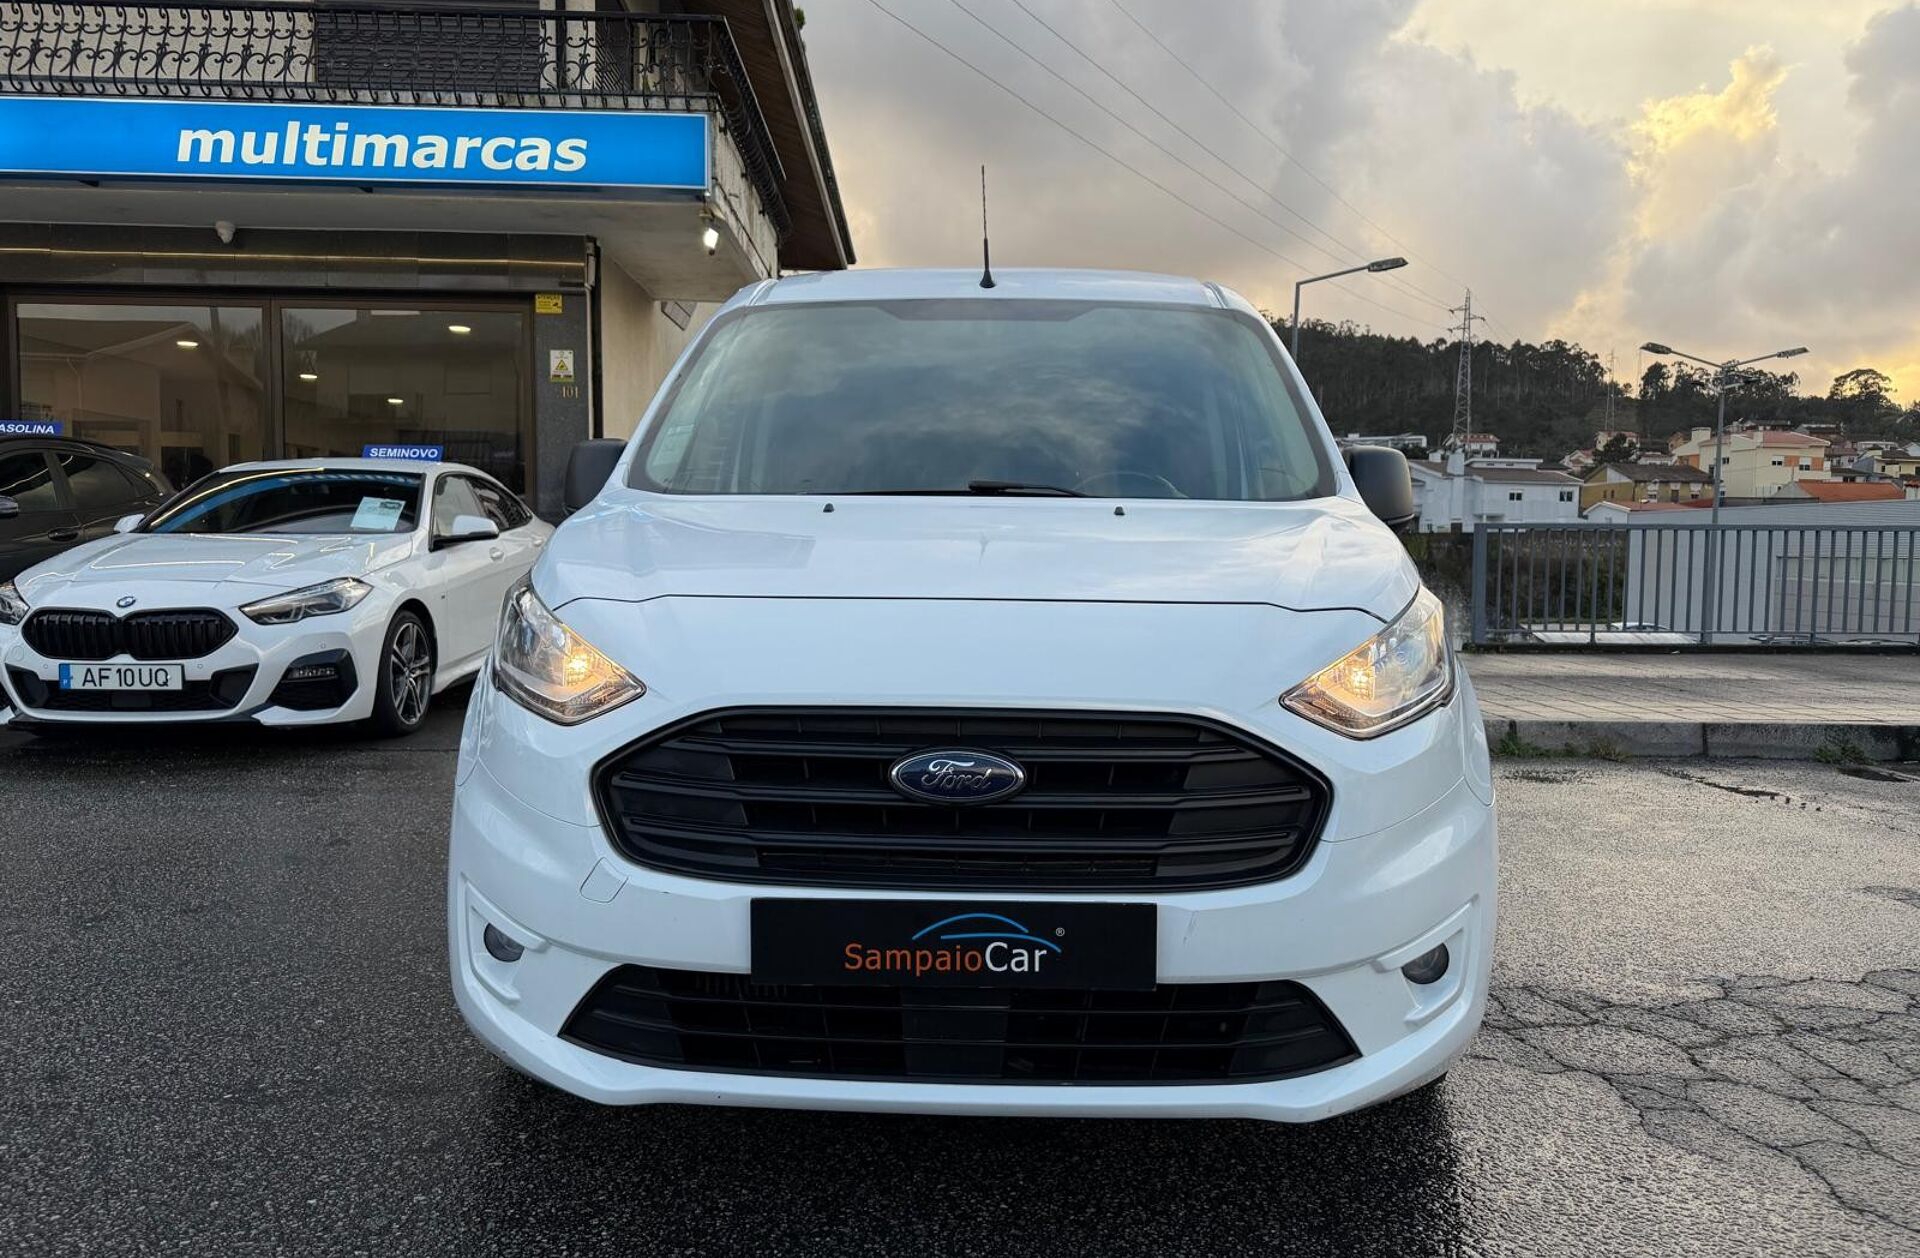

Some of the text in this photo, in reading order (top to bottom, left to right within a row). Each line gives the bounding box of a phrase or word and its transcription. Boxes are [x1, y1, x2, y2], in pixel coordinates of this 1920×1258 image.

[177, 121, 588, 172] multimarcas
[369, 447, 438, 458] SEMINOVO
[921, 759, 992, 789] Ford
[844, 941, 1047, 977] SampaioCar
